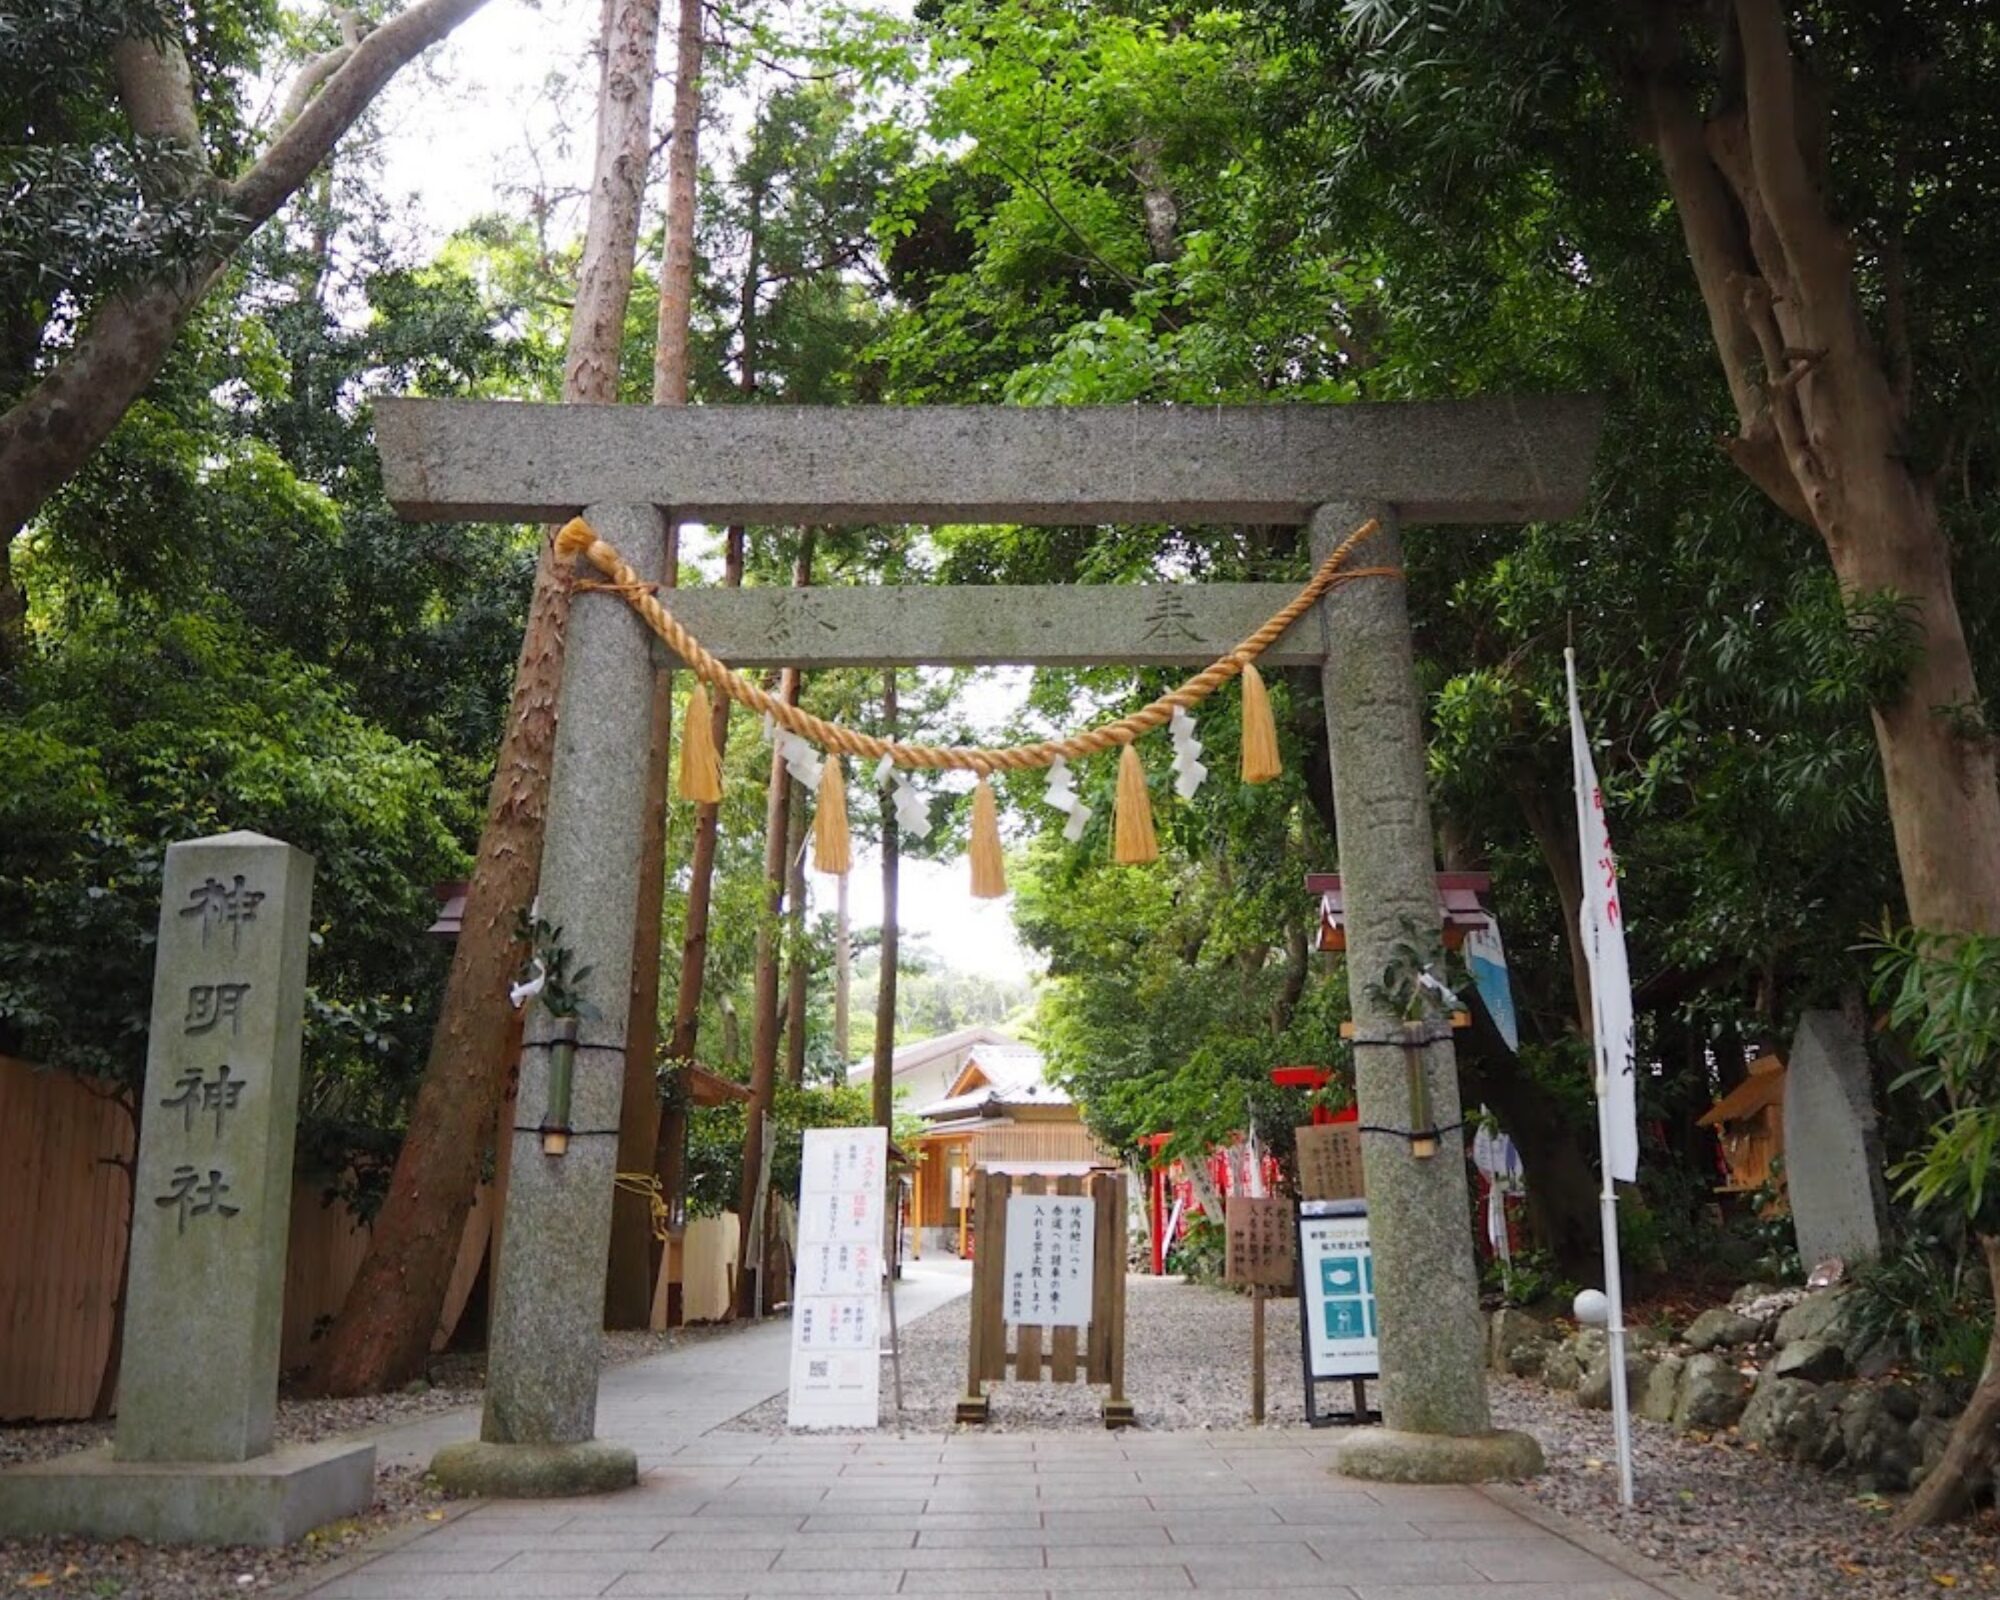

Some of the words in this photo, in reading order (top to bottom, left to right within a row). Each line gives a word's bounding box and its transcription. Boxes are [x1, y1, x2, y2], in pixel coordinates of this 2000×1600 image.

[1141, 590, 1209, 646] 奉
[154, 875, 267, 1235] 神明神社
